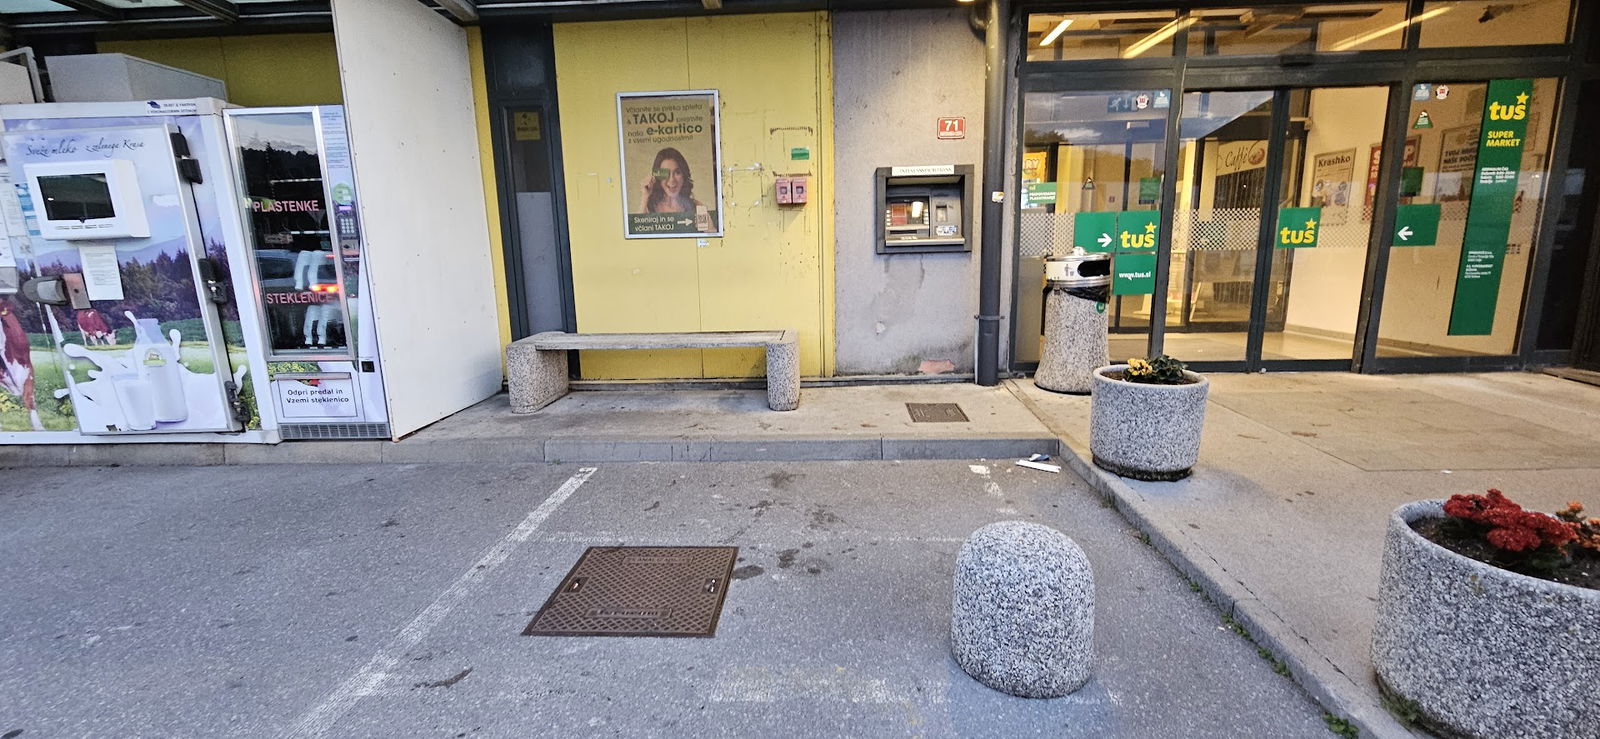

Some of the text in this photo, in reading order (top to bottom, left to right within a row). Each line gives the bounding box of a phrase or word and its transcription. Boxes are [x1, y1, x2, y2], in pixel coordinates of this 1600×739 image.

[632, 112, 674, 125] TAKOJ
[646, 123, 703, 136] e-kartico
[944, 119, 959, 132] 71
[1487, 130, 1514, 139] SUPER
[1486, 138, 1521, 147] MARKET
[252, 200, 320, 212] PLASTENKE
[266, 291, 335, 304] STEKLENICE
[310, 388, 334, 396] predal
[311, 396, 350, 404] steklenico
